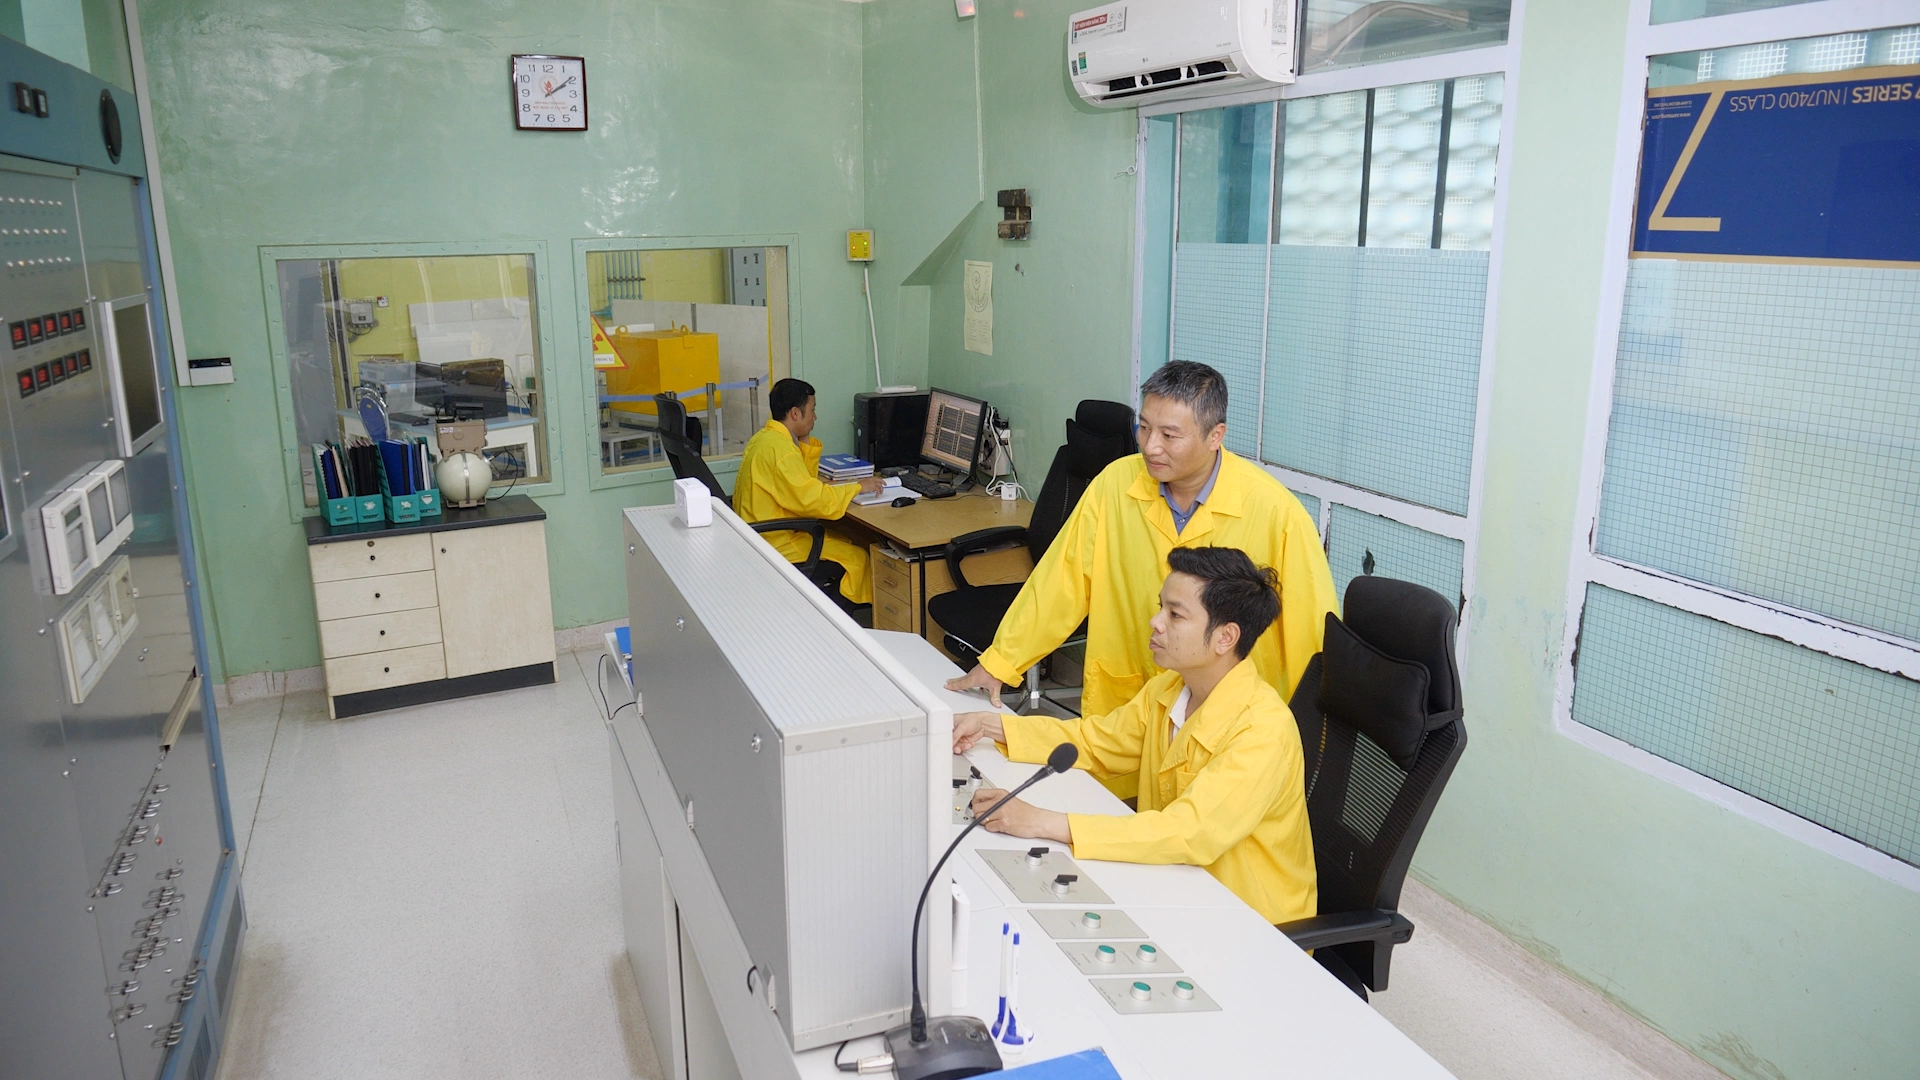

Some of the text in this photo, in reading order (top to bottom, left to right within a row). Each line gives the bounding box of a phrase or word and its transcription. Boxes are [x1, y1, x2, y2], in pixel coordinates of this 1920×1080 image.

[528, 64, 536, 73] 11
[542, 64, 554, 73] 12
[520, 74, 530, 83] 10
[568, 76, 577, 84] 2
[522, 88, 530, 97] 9
[569, 89, 577, 98] 3
[1851, 83, 1913, 104] SERIES
[1729, 92, 1775, 113] CLASS
[1778, 89, 1840, 110] NU7400
[522, 103, 531, 112] 8
[570, 105, 578, 113] 4
[533, 114, 541, 122] 7
[547, 114, 556, 122] 6
[562, 114, 571, 123] 5
